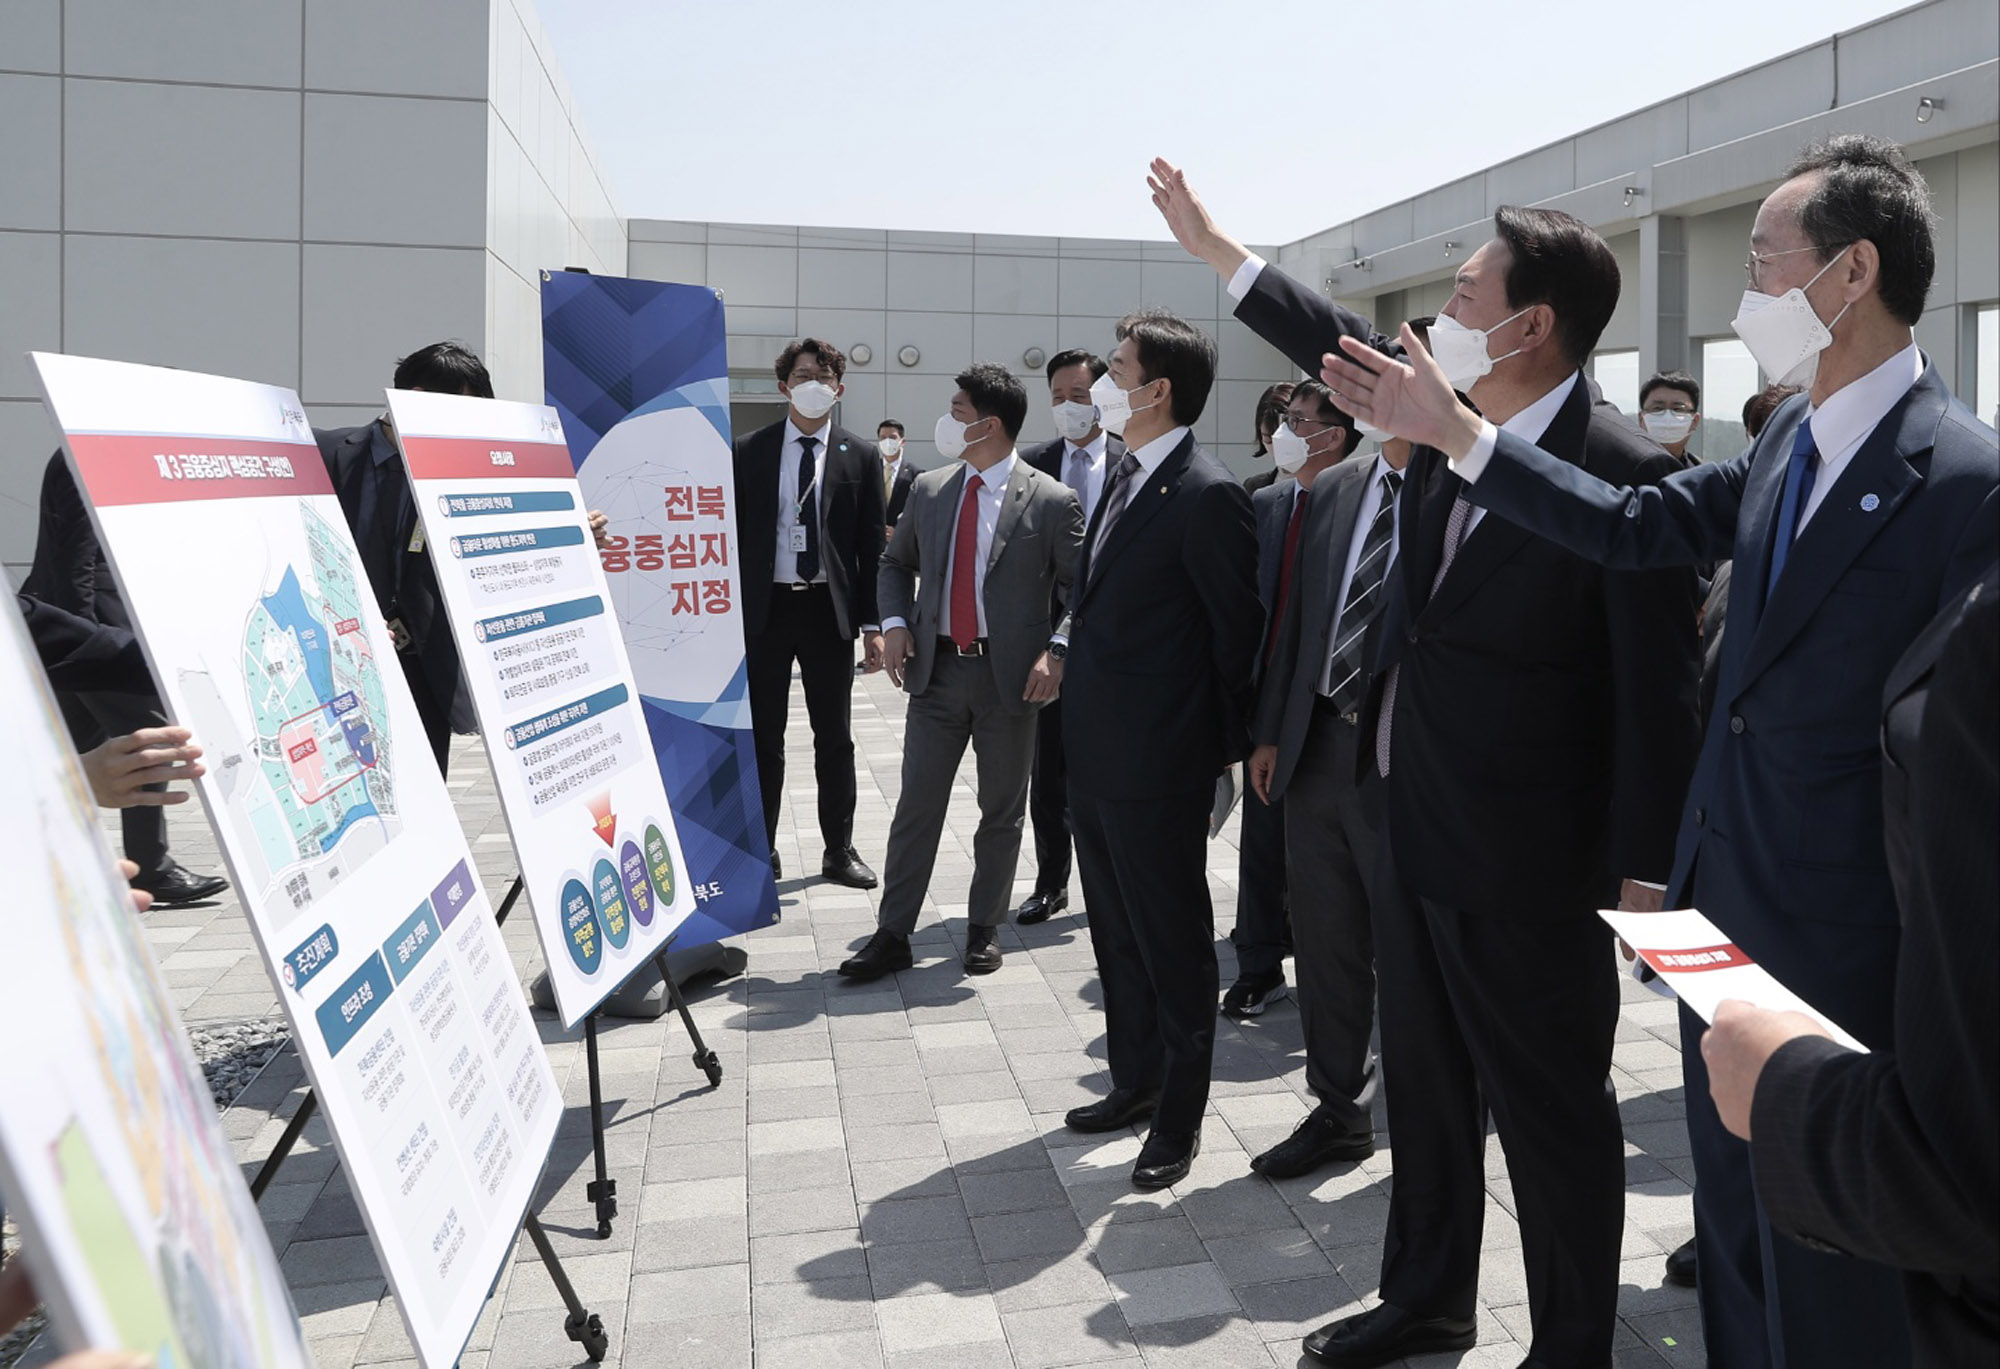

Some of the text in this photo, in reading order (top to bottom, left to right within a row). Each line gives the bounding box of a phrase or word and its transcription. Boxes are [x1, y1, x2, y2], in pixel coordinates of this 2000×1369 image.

[153, 455, 172, 477] 제
[167, 456, 183, 477] 3
[180, 456, 231, 477] 금융중심지
[228, 457, 266, 476] 핵심공간
[665, 486, 725, 521] 전북
[600, 532, 728, 573] 융중심지
[670, 579, 732, 616] 지정
[693, 881, 723, 902] 북도
[295, 933, 332, 975] 추진계획
[341, 980, 373, 1023] 인프라 조성
